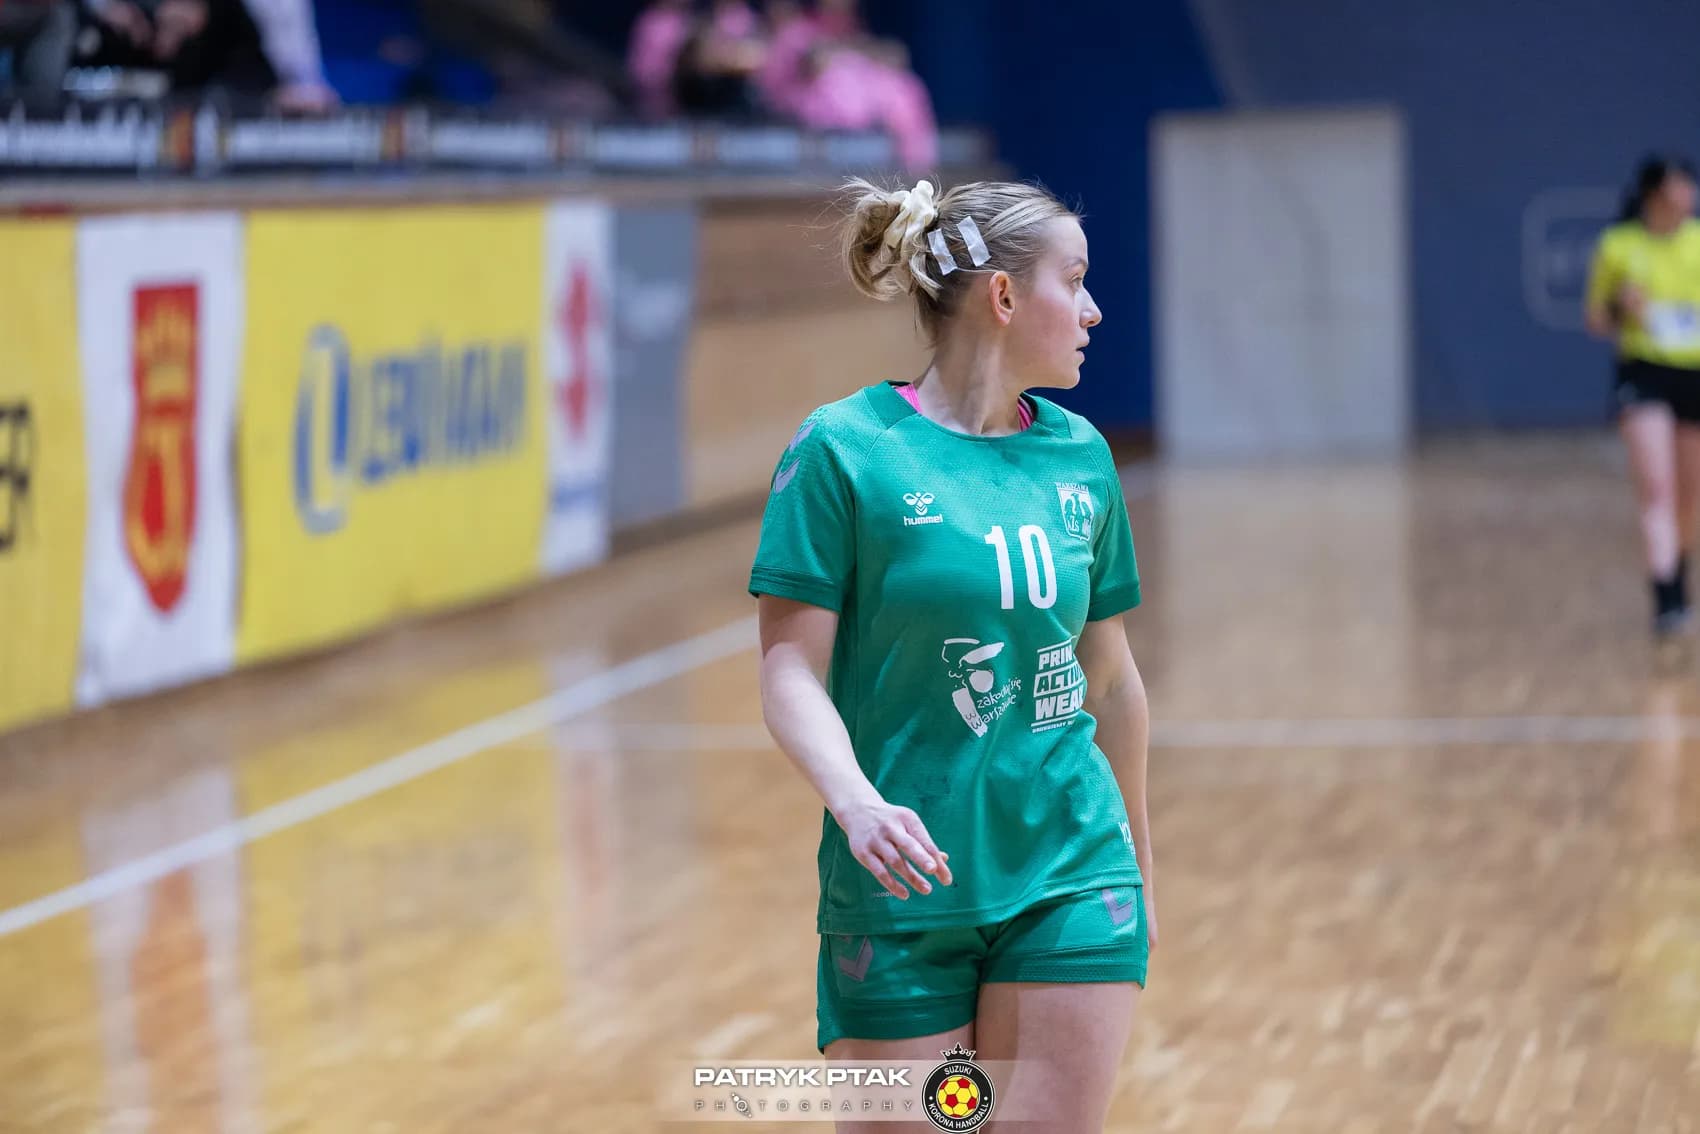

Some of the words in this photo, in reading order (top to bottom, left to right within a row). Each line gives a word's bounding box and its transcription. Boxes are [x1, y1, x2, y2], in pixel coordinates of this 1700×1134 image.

[903, 513, 944, 527] hummel
[984, 524, 1058, 610] 10
[1038, 643, 1074, 671] PRIN
